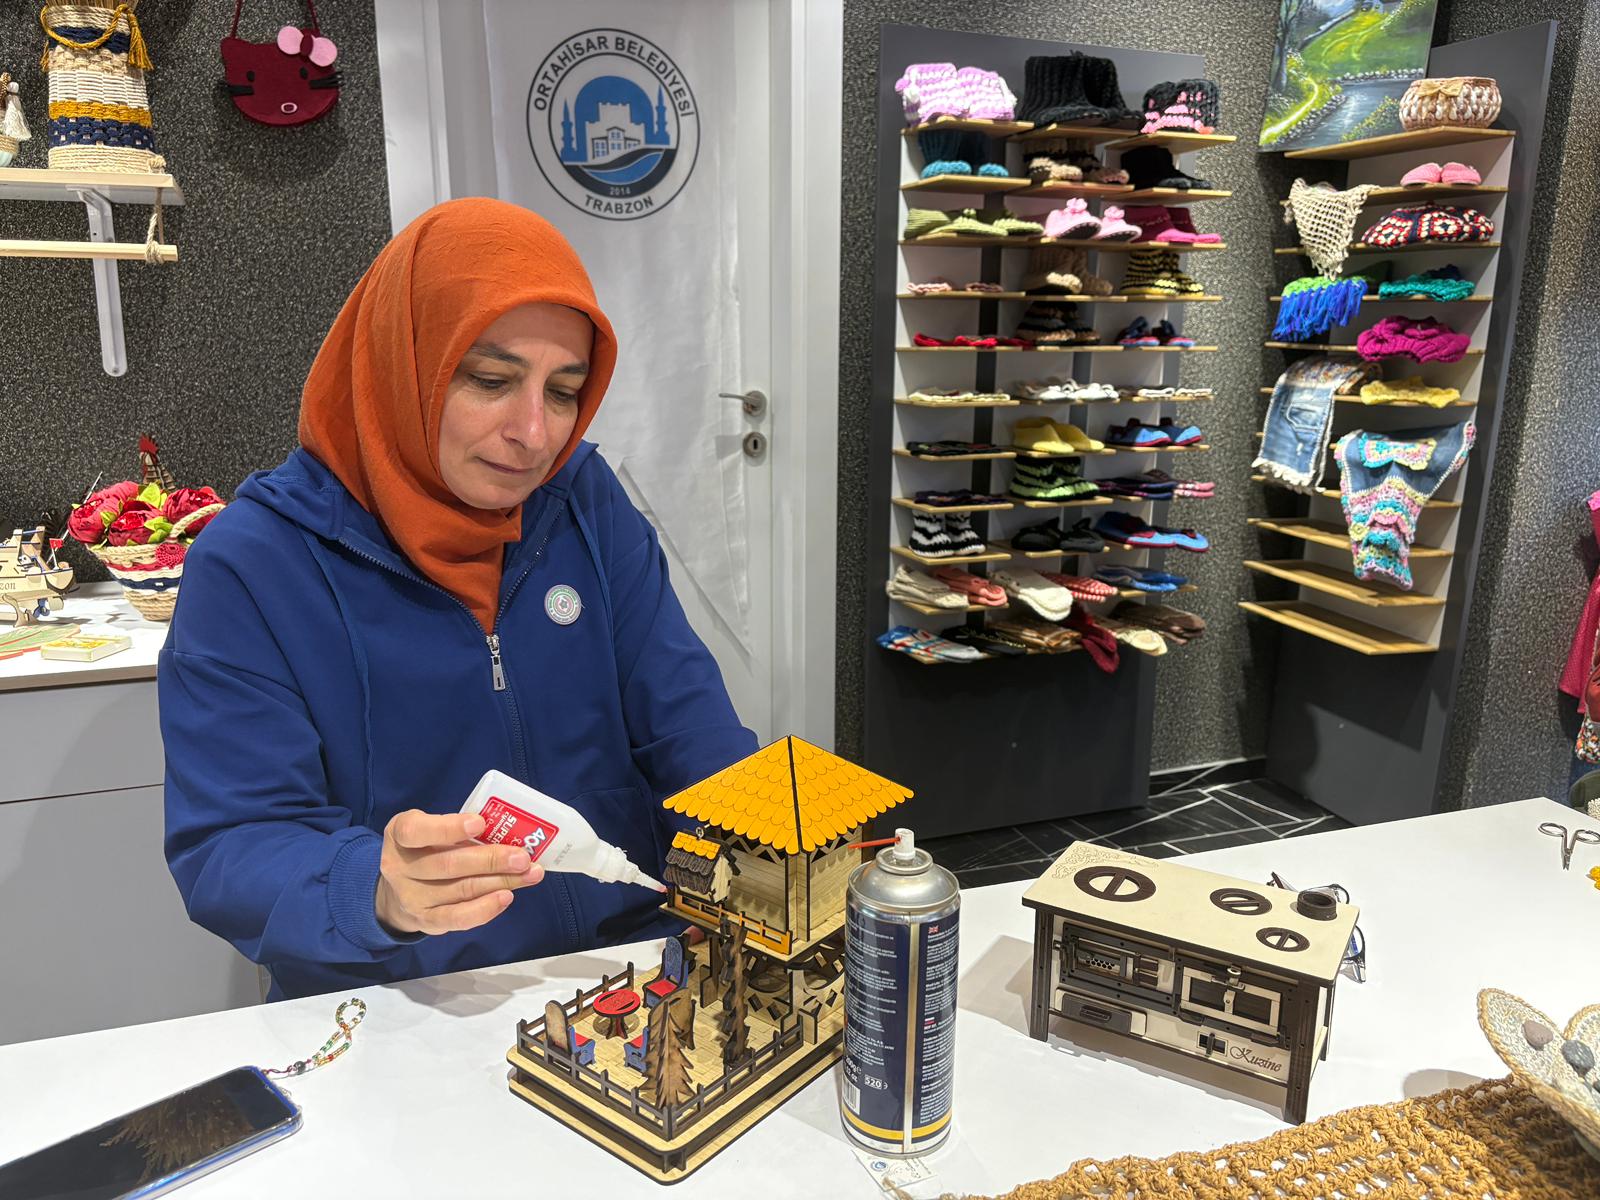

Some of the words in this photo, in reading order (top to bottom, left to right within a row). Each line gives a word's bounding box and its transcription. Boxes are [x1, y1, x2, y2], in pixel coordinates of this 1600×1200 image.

[534, 36, 609, 111] ORTAHİSAR
[615, 37, 695, 117] BELEDİYESİ
[609, 187, 632, 196] 2014
[585, 194, 654, 214] TRABZON
[1230, 1046, 1282, 1072] Kuzine
[865, 1076, 882, 1089] 520
